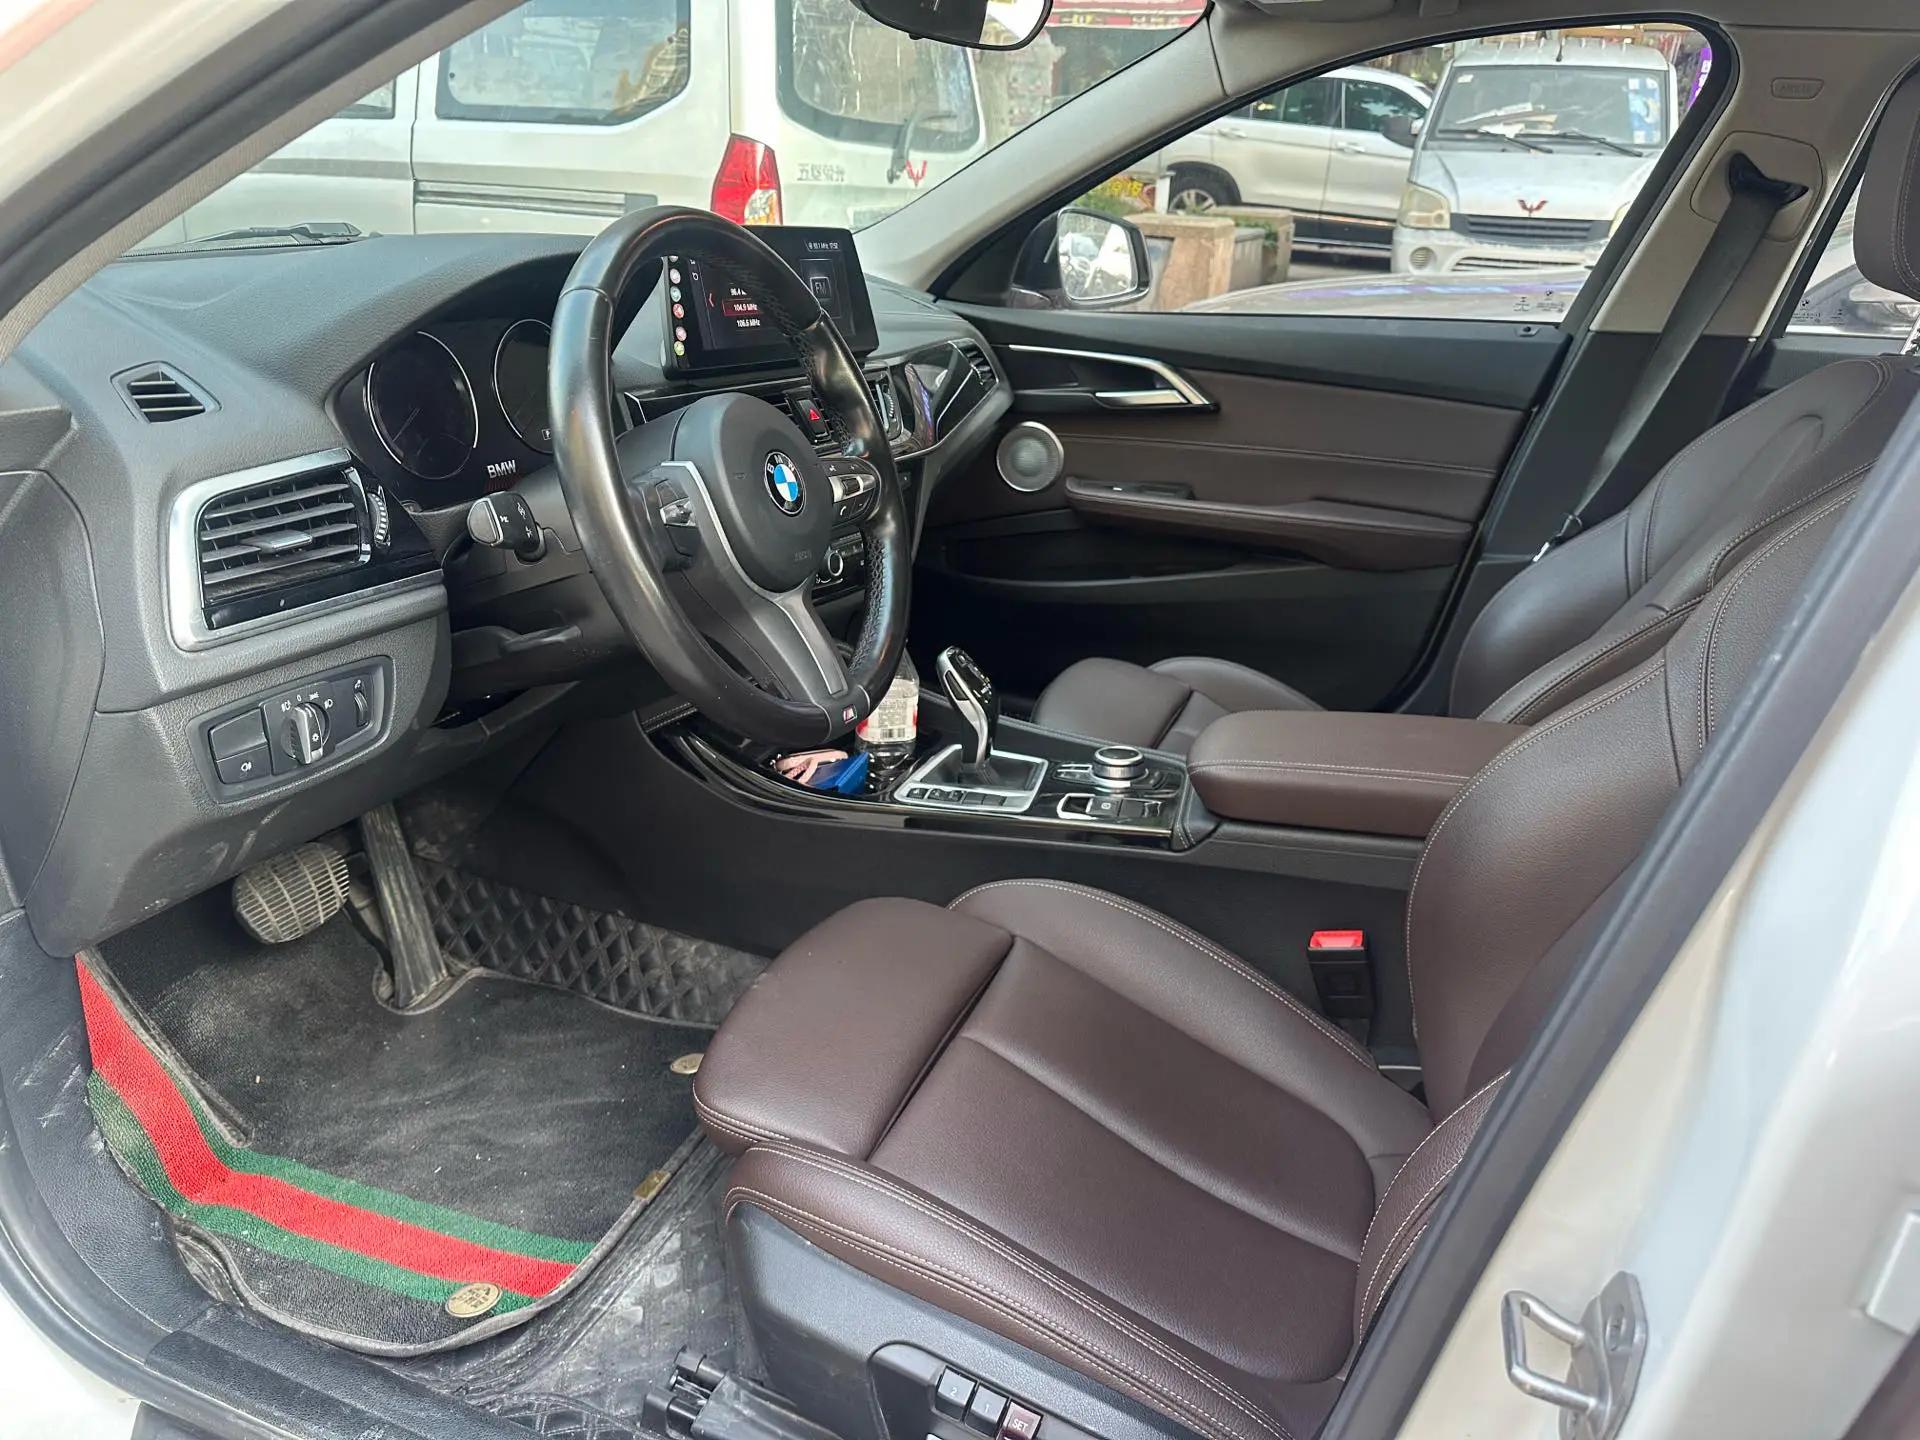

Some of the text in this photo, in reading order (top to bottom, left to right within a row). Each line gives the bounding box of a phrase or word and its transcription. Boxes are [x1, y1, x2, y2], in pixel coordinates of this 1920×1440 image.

[487, 460, 516, 478] BMW
[767, 454, 795, 474] BMW
[950, 1387, 957, 1397] 2
[1012, 1418, 1028, 1433] SET
